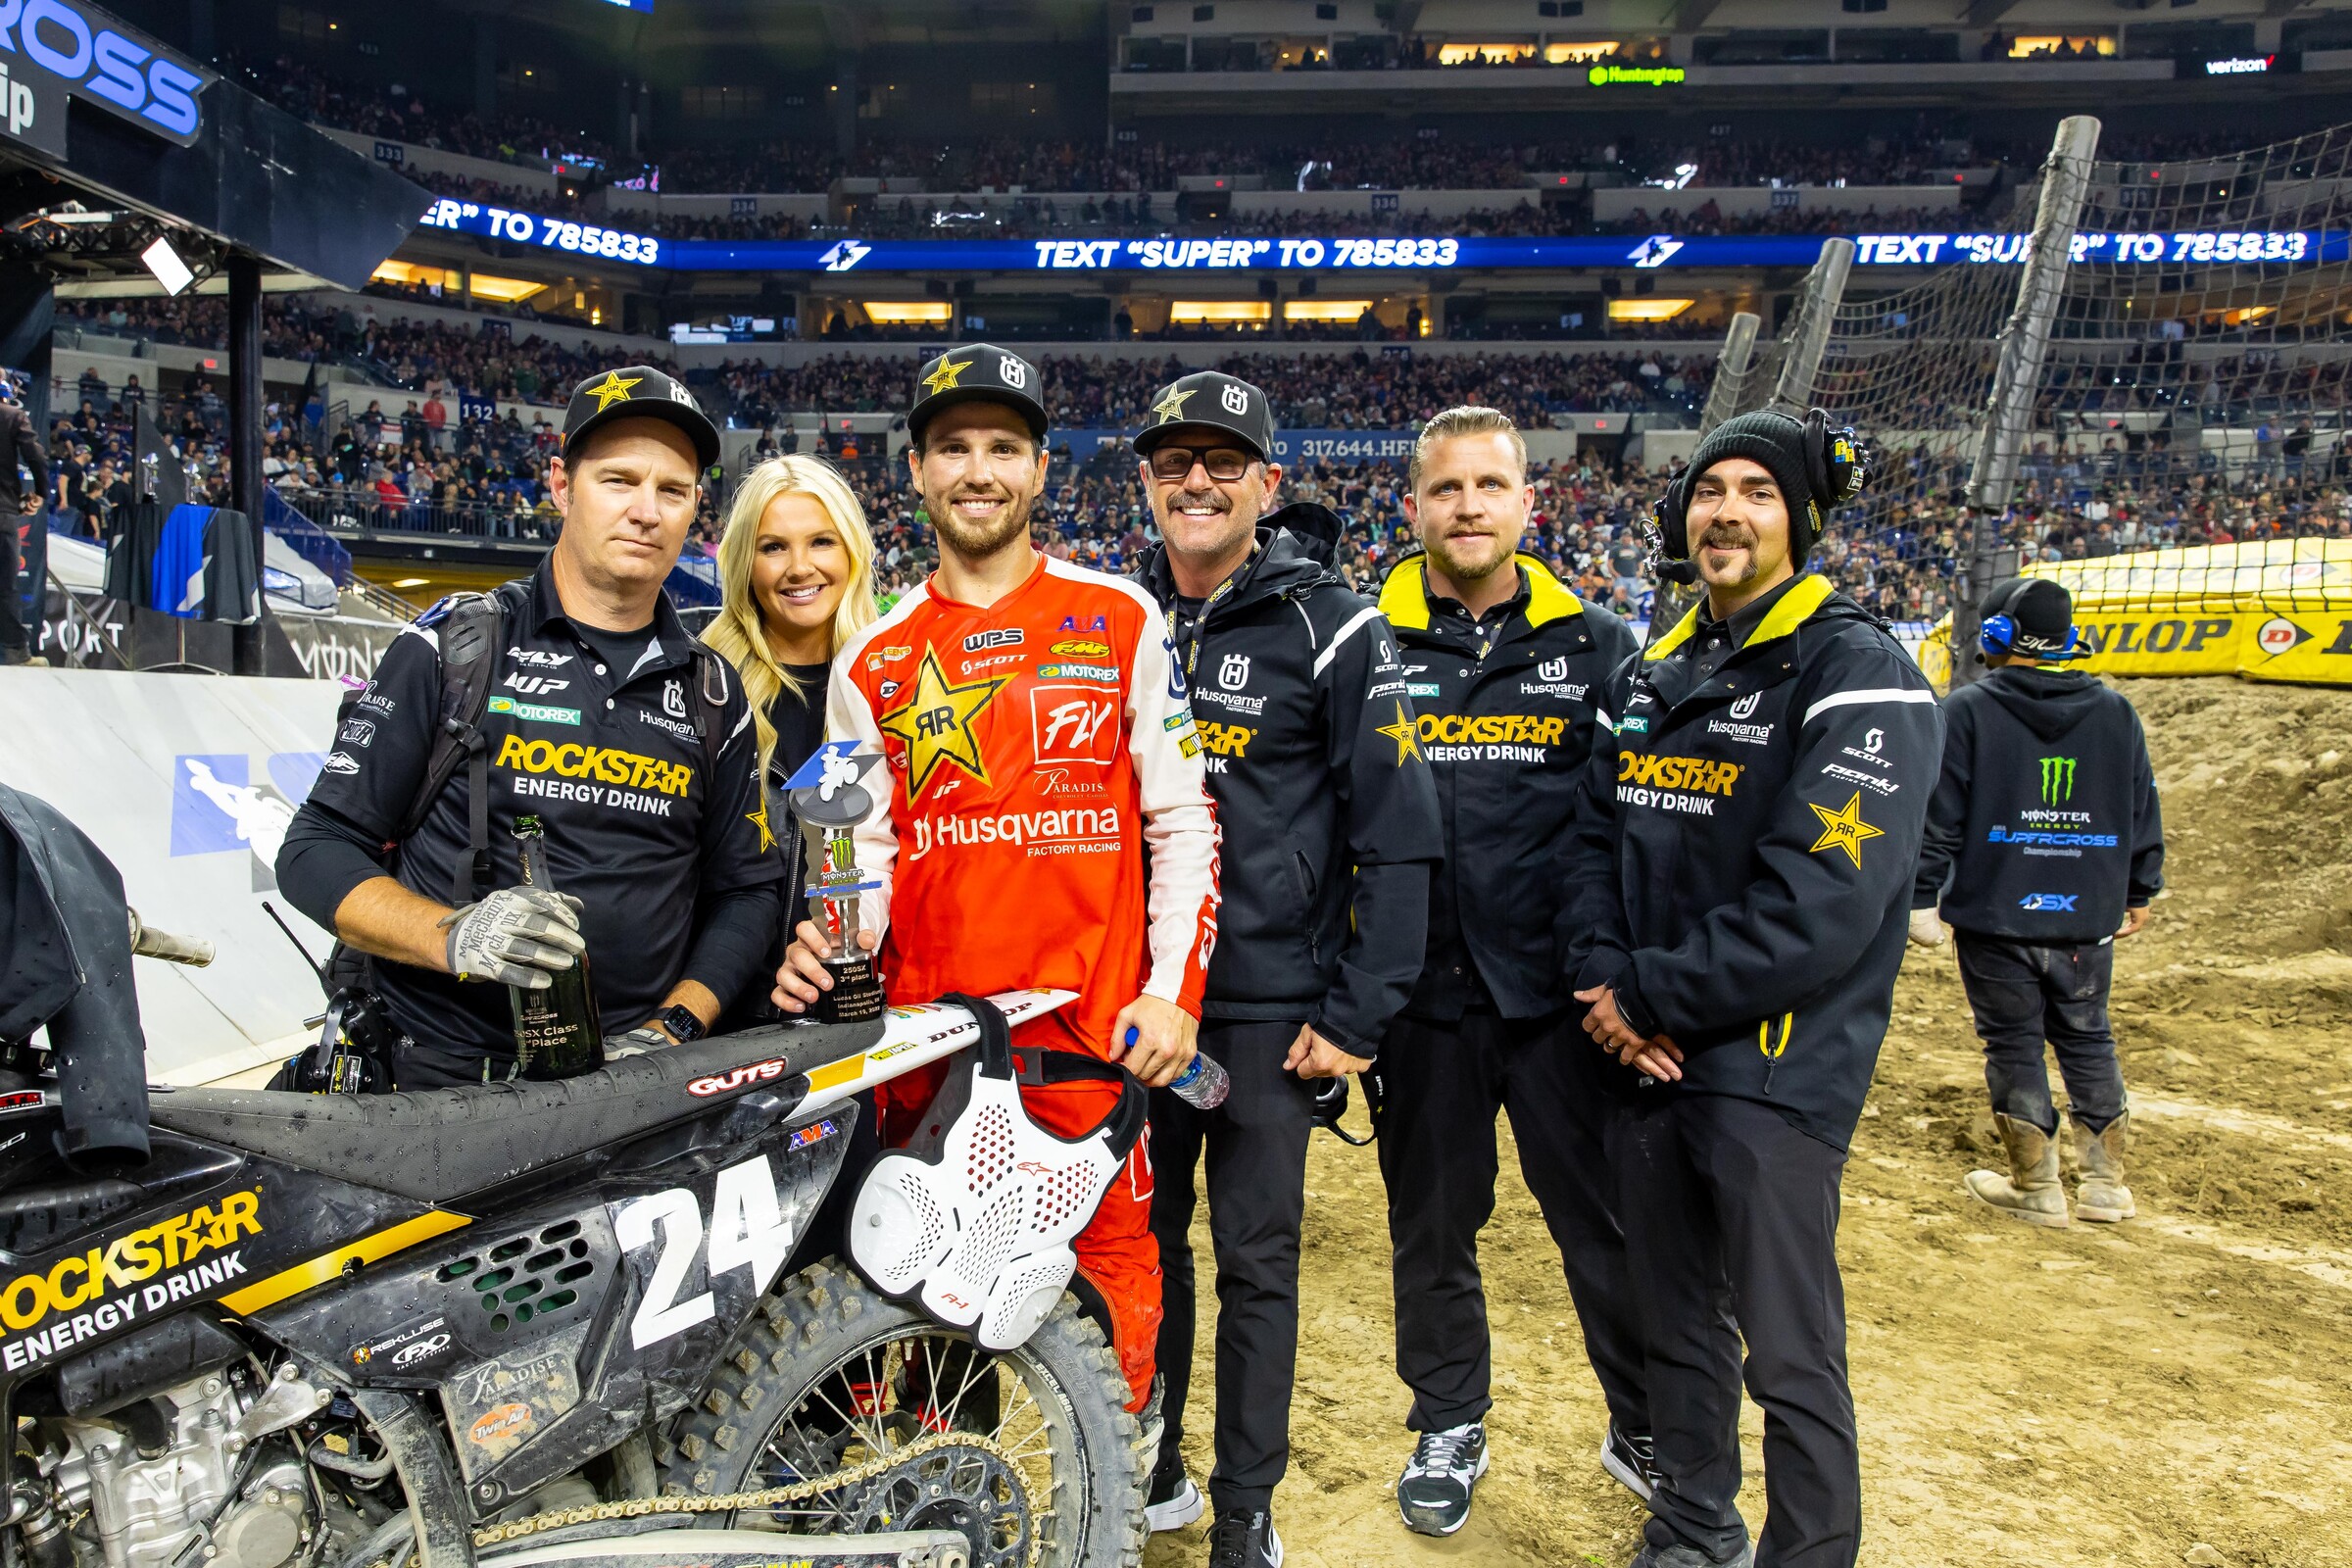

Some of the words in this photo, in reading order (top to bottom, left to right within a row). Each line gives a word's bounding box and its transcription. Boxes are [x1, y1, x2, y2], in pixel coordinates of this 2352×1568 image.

[1608, 66, 1685, 86] Huntington
[2207, 58, 2267, 74] verizon
[488, 209, 533, 241] TO
[542, 219, 659, 264] 785833
[1856, 235, 1946, 263] TEXT
[2115, 234, 2163, 263] TO
[2173, 232, 2308, 261] 785833
[1035, 241, 1119, 268] TEXT
[1278, 241, 1324, 267] TO
[1333, 239, 1458, 267] 785833
[463, 403, 493, 422] 132
[964, 629, 1022, 652] WPS
[1053, 642, 1109, 655] FMF
[974, 654, 1028, 669] SCOTT
[1187, 640, 1198, 675] ROCKSTAR
[1061, 665, 1119, 681] MOTOREX
[1195, 687, 1263, 710] Husqvarna
[1521, 683, 1586, 697] Husqvarna
[1044, 701, 1112, 751] FLY
[1707, 719, 1770, 738] Husqvarna
[1424, 746, 1485, 760] NERGY
[1487, 745, 1546, 762] DRINK
[1841, 746, 1893, 768] SCOTT
[495, 734, 692, 798] ROCKSTAR
[1033, 768, 1106, 796] PARADIS
[514, 776, 605, 805] ENERGY
[606, 790, 672, 817] DRINK
[1662, 793, 1715, 815] DRINK
[936, 807, 1120, 846] Husqvarna
[2022, 809, 2090, 823] MONSTER
[1027, 845, 1076, 858] FACTORY
[1079, 842, 1121, 854] RACING
[2023, 846, 2082, 858] Championship
[843, 964, 866, 974] 250SX
[852, 973, 870, 983] place
[838, 1000, 874, 1009] Indianapolis,
[544, 1024, 578, 1036] Class
[930, 1003, 1032, 1043] DUNOP
[532, 1036, 567, 1047] Place
[688, 1059, 785, 1096] GUTS
[788, 1119, 838, 1152] AMA
[613, 1153, 795, 1350] 24
[0, 1191, 263, 1338] OCKSTAR
[2, 1293, 137, 1372] ENERGY
[143, 1250, 248, 1313] DRINK
[941, 1293, 970, 1309] A-1
[370, 1317, 445, 1355] REKLUSE
[397, 1355, 426, 1371] FACTORY
[452, 1356, 556, 1406] PAADISE
[1036, 1362, 1060, 1393] EXCEL
[474, 1419, 506, 1440] Twin
[506, 1408, 526, 1426] Air
